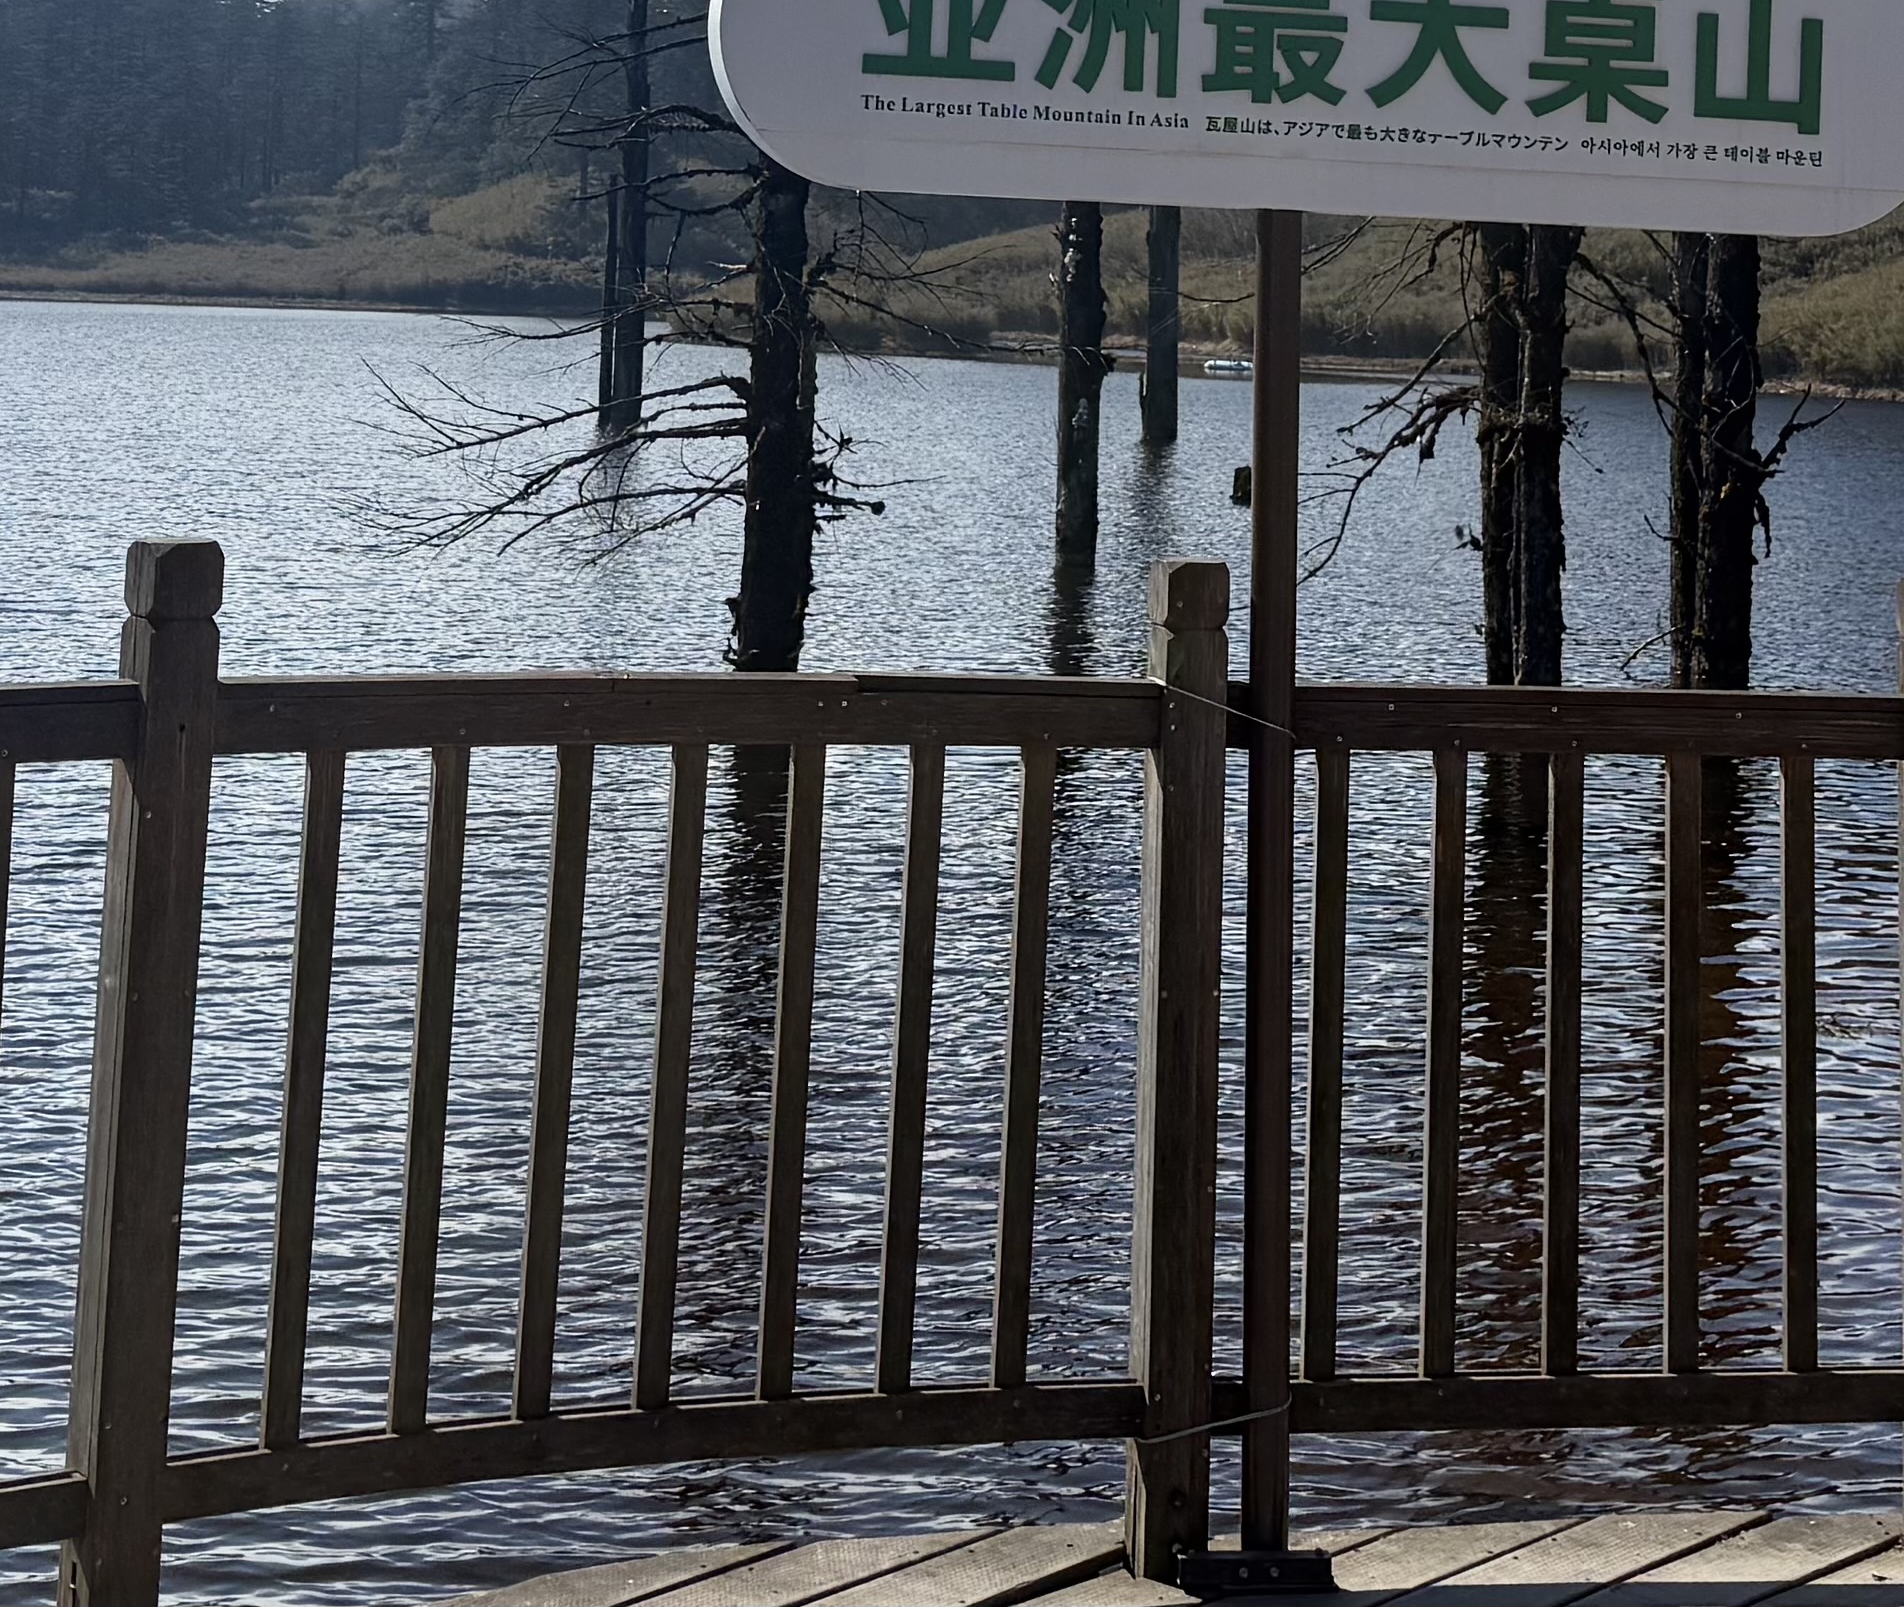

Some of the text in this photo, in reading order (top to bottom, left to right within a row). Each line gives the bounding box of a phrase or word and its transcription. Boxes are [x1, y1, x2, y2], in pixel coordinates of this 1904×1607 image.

[860, 94, 1190, 129] The Largest Table Mountain In Asia
[1580, 137, 1661, 159] 아시아에서
[1666, 142, 1699, 161] 가장
[1702, 144, 1719, 162] 큰
